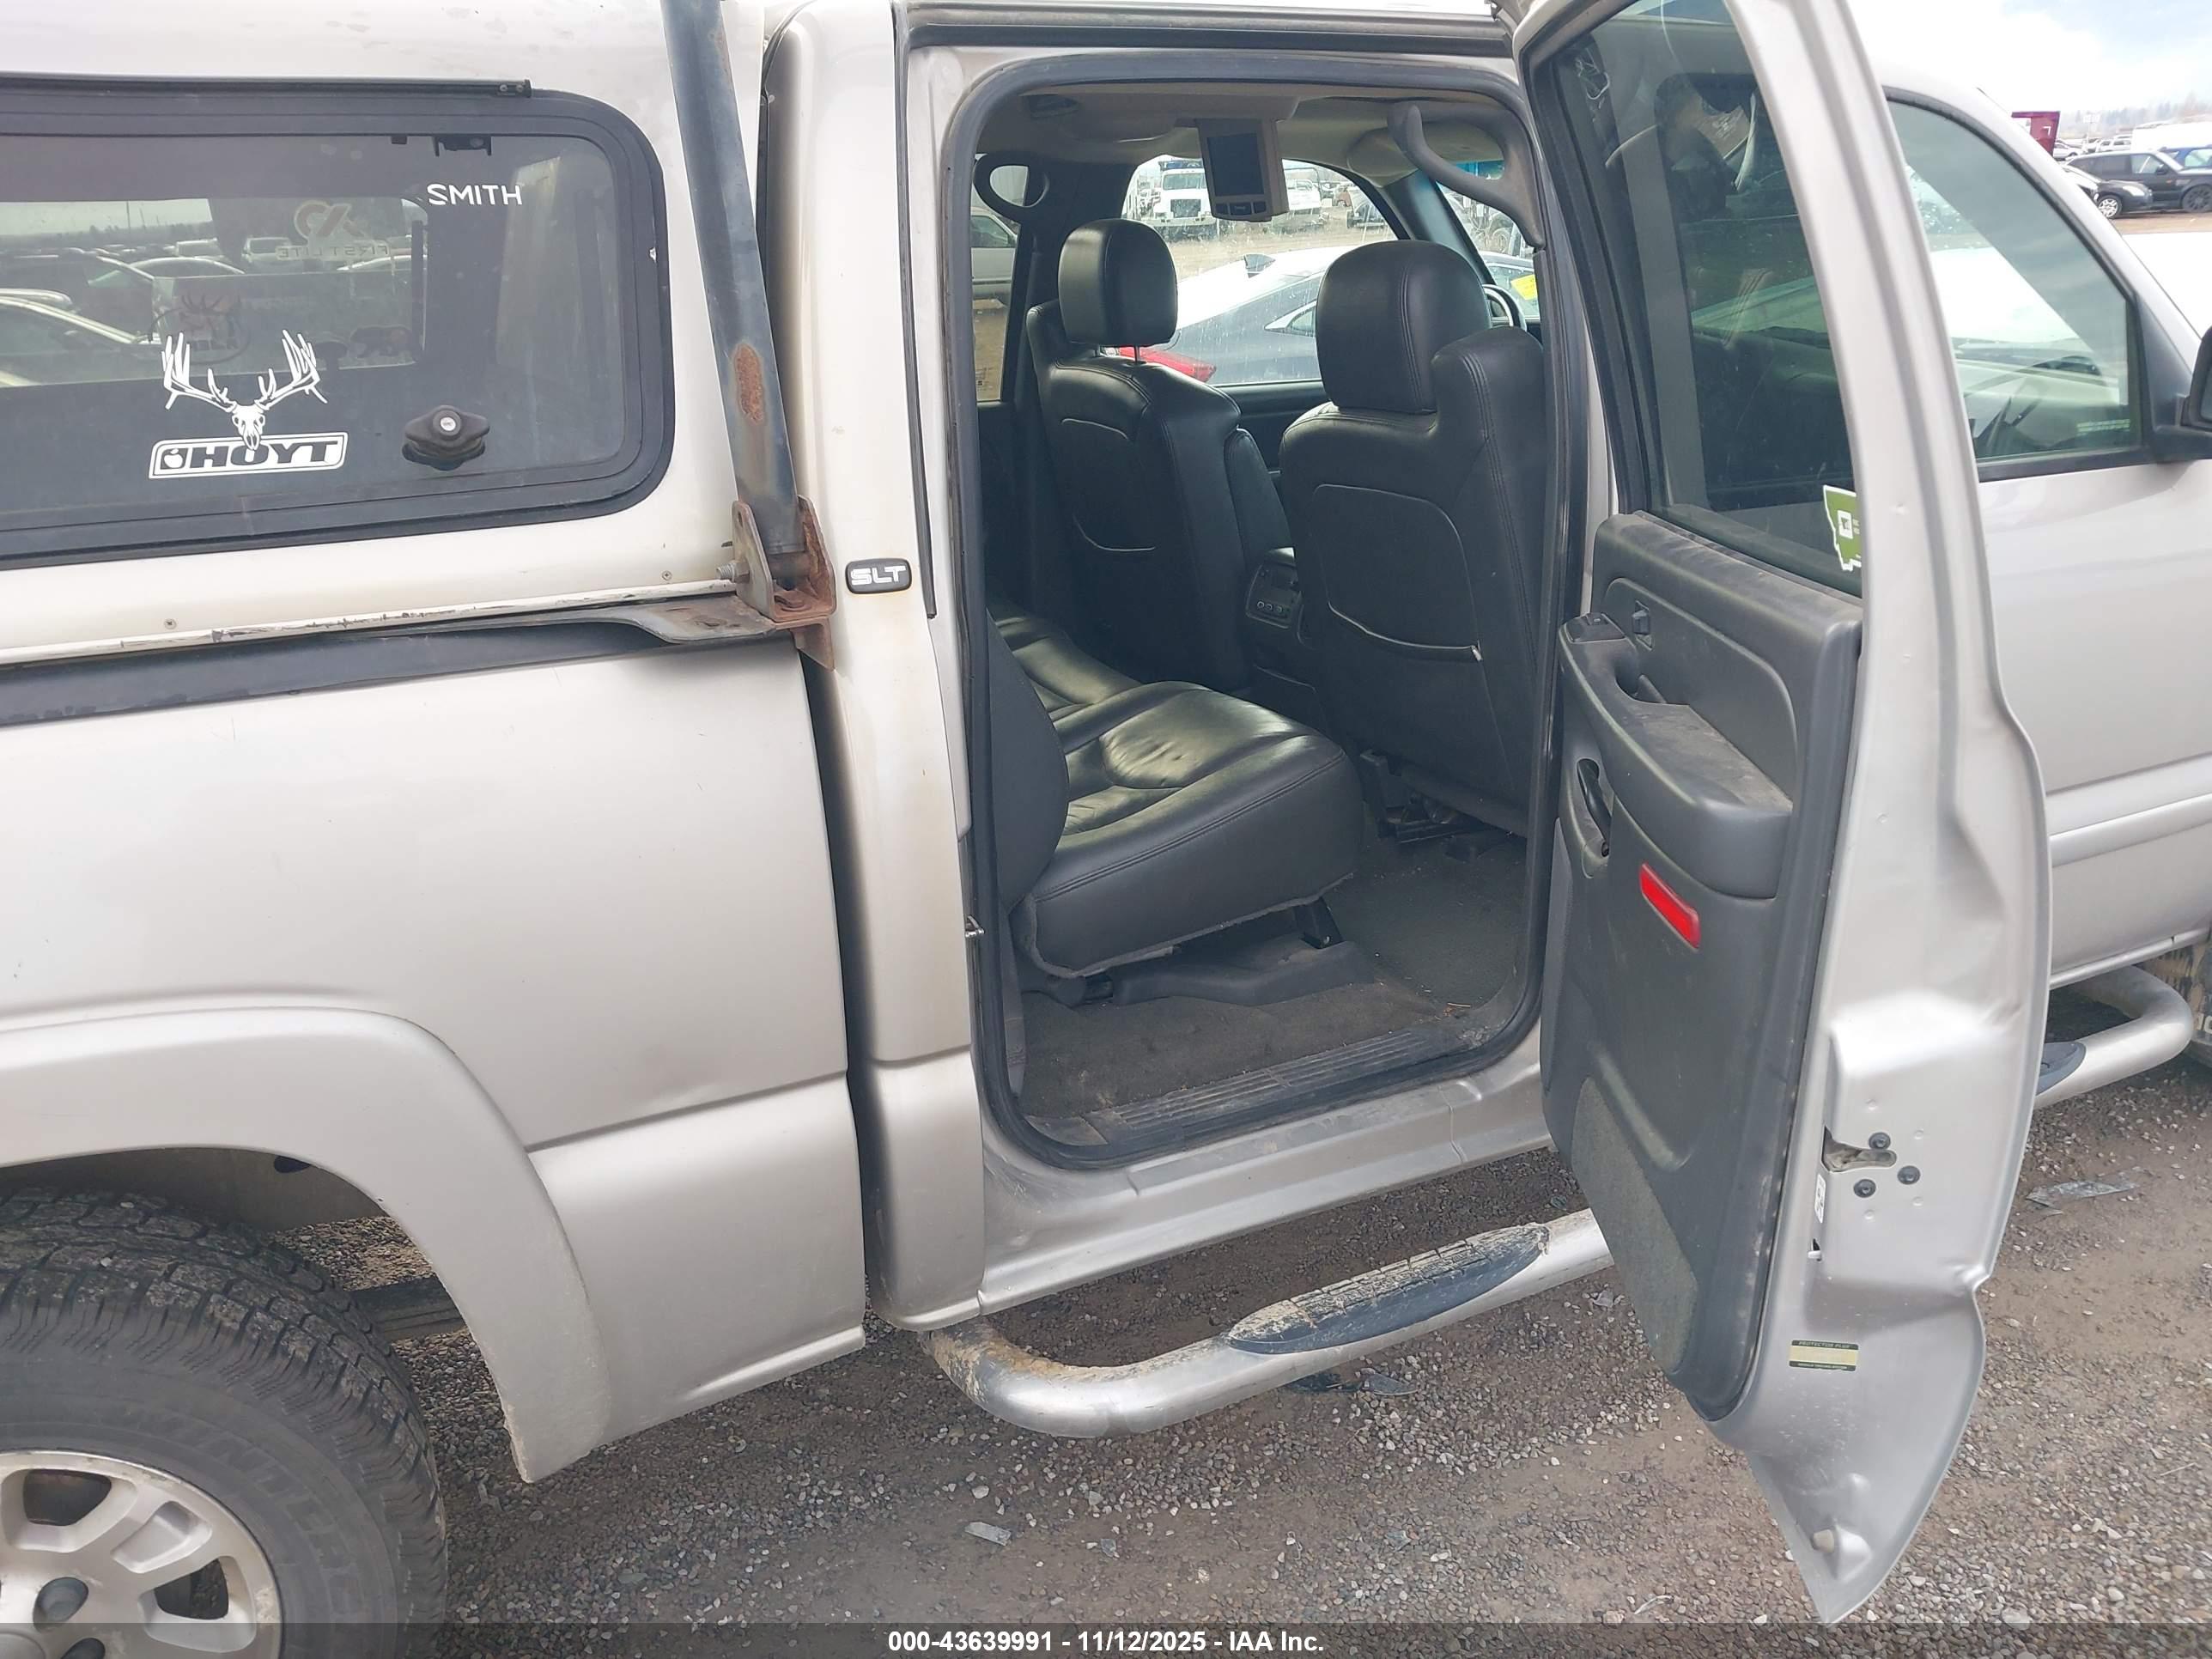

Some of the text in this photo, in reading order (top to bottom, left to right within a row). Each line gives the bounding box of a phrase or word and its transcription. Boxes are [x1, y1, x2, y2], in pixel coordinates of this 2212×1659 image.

[427, 183, 523, 205] SMITH
[189, 441, 338, 466] HOYT
[850, 565, 907, 586] SLT
